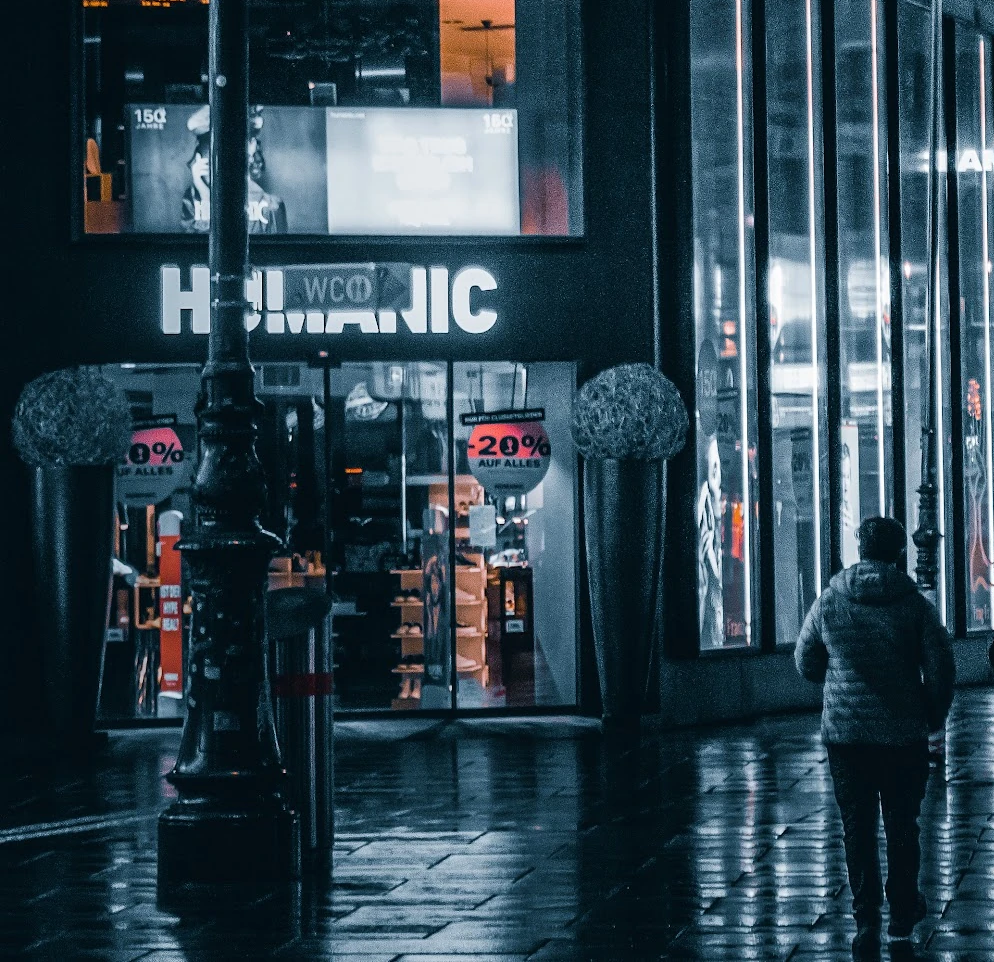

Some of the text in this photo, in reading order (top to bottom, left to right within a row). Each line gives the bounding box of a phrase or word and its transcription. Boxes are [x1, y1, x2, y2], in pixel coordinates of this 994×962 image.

[468, 435, 551, 456] -20%
[478, 458, 541, 469] AUF ALLES
